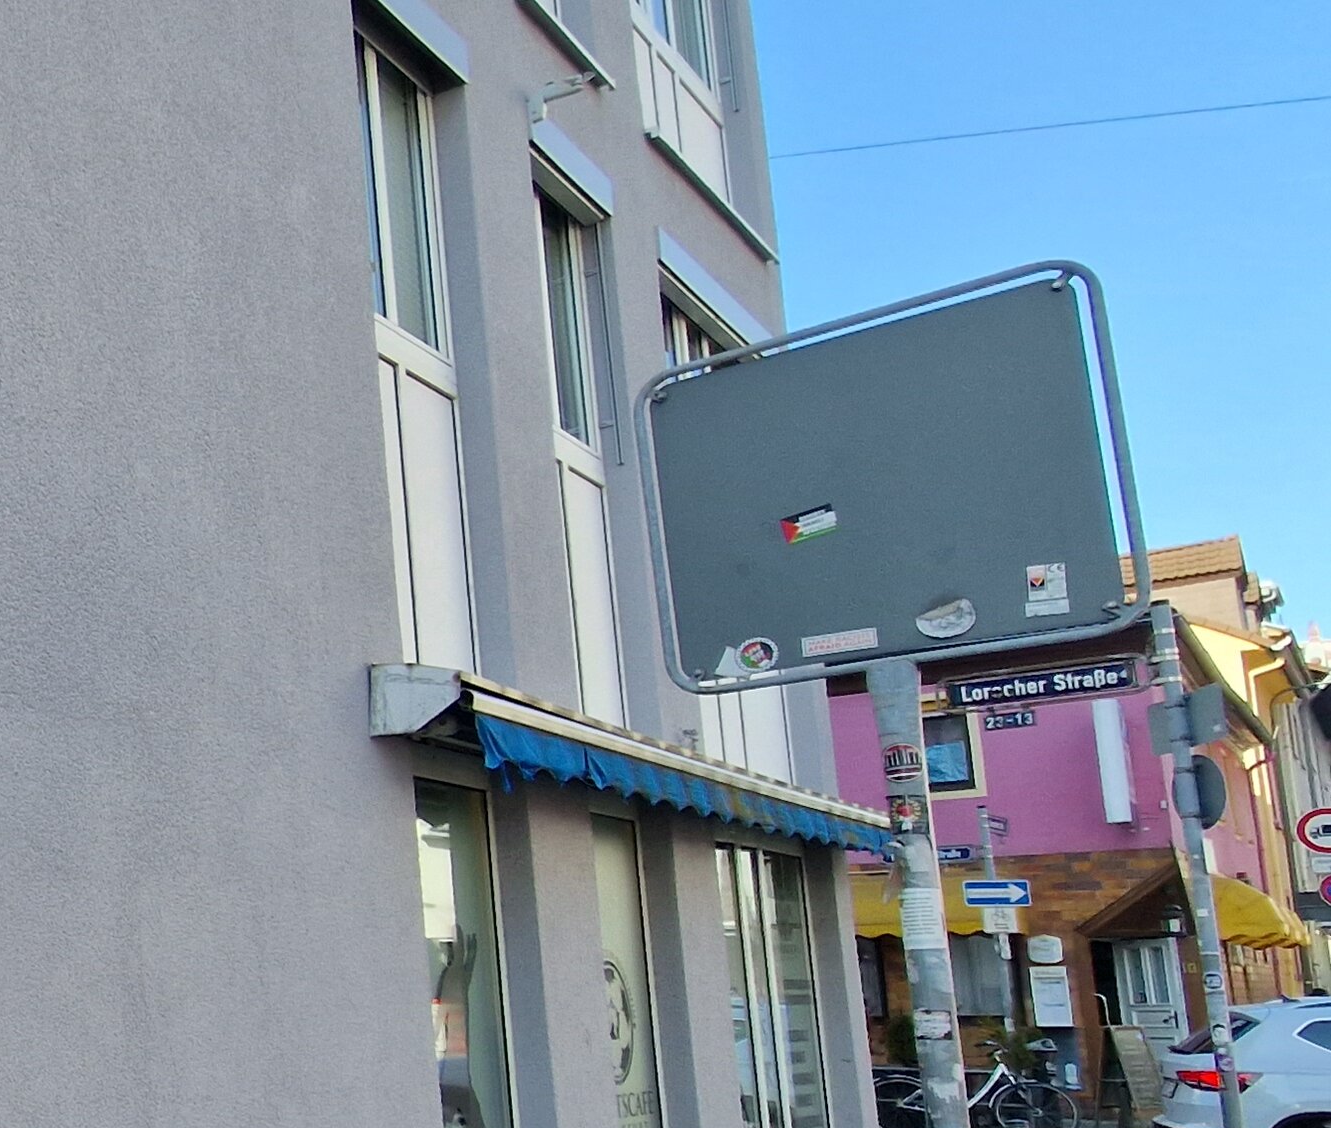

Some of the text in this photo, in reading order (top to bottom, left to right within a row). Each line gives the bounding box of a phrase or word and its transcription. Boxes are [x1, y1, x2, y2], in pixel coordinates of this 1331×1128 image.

[1052, 669, 1119, 692] Straße
[985, 713, 1034, 730] 23-13
[616, 1091, 655, 1118] TSCAFE
